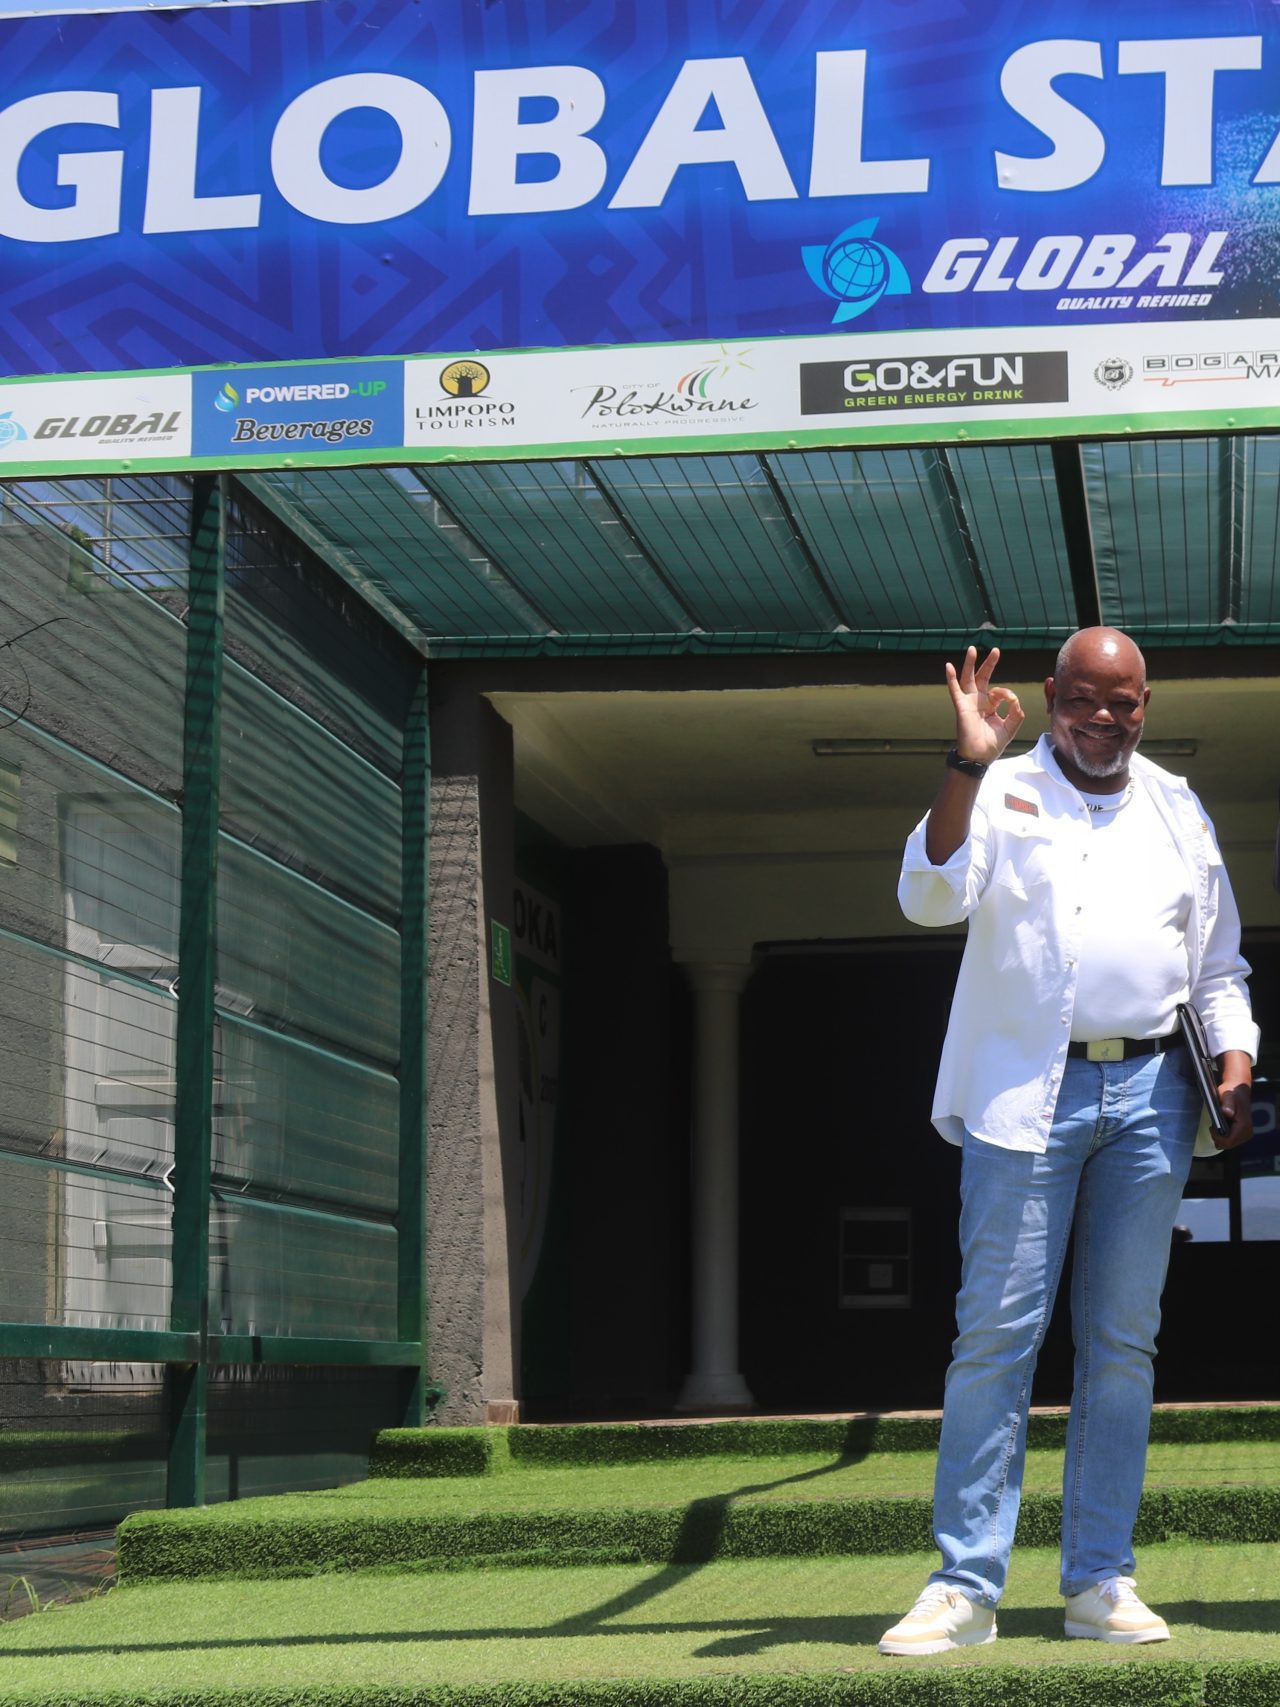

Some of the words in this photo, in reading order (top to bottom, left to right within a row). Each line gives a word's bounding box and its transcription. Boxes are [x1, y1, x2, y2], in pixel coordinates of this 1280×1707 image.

[0, 49, 931, 243] GLOBAL
[922, 231, 1228, 293] GLOBAL
[1056, 295, 1134, 311] QUALITY
[1137, 293, 1212, 308] REFINED
[844, 356, 1024, 393] GO&FUN
[246, 381, 386, 404] POWERED-UP
[844, 396, 898, 408] GREEN
[904, 392, 967, 405] ENERGY
[972, 390, 1024, 401] DRINK
[416, 402, 515, 419] LIMPOPO
[33, 411, 182, 440] GLOBAL
[232, 417, 373, 444] Beverages
[416, 416, 516, 431] TOURISM
[592, 419, 659, 429] NATURALLY
[664, 416, 745, 425] PROGRESSIVE
